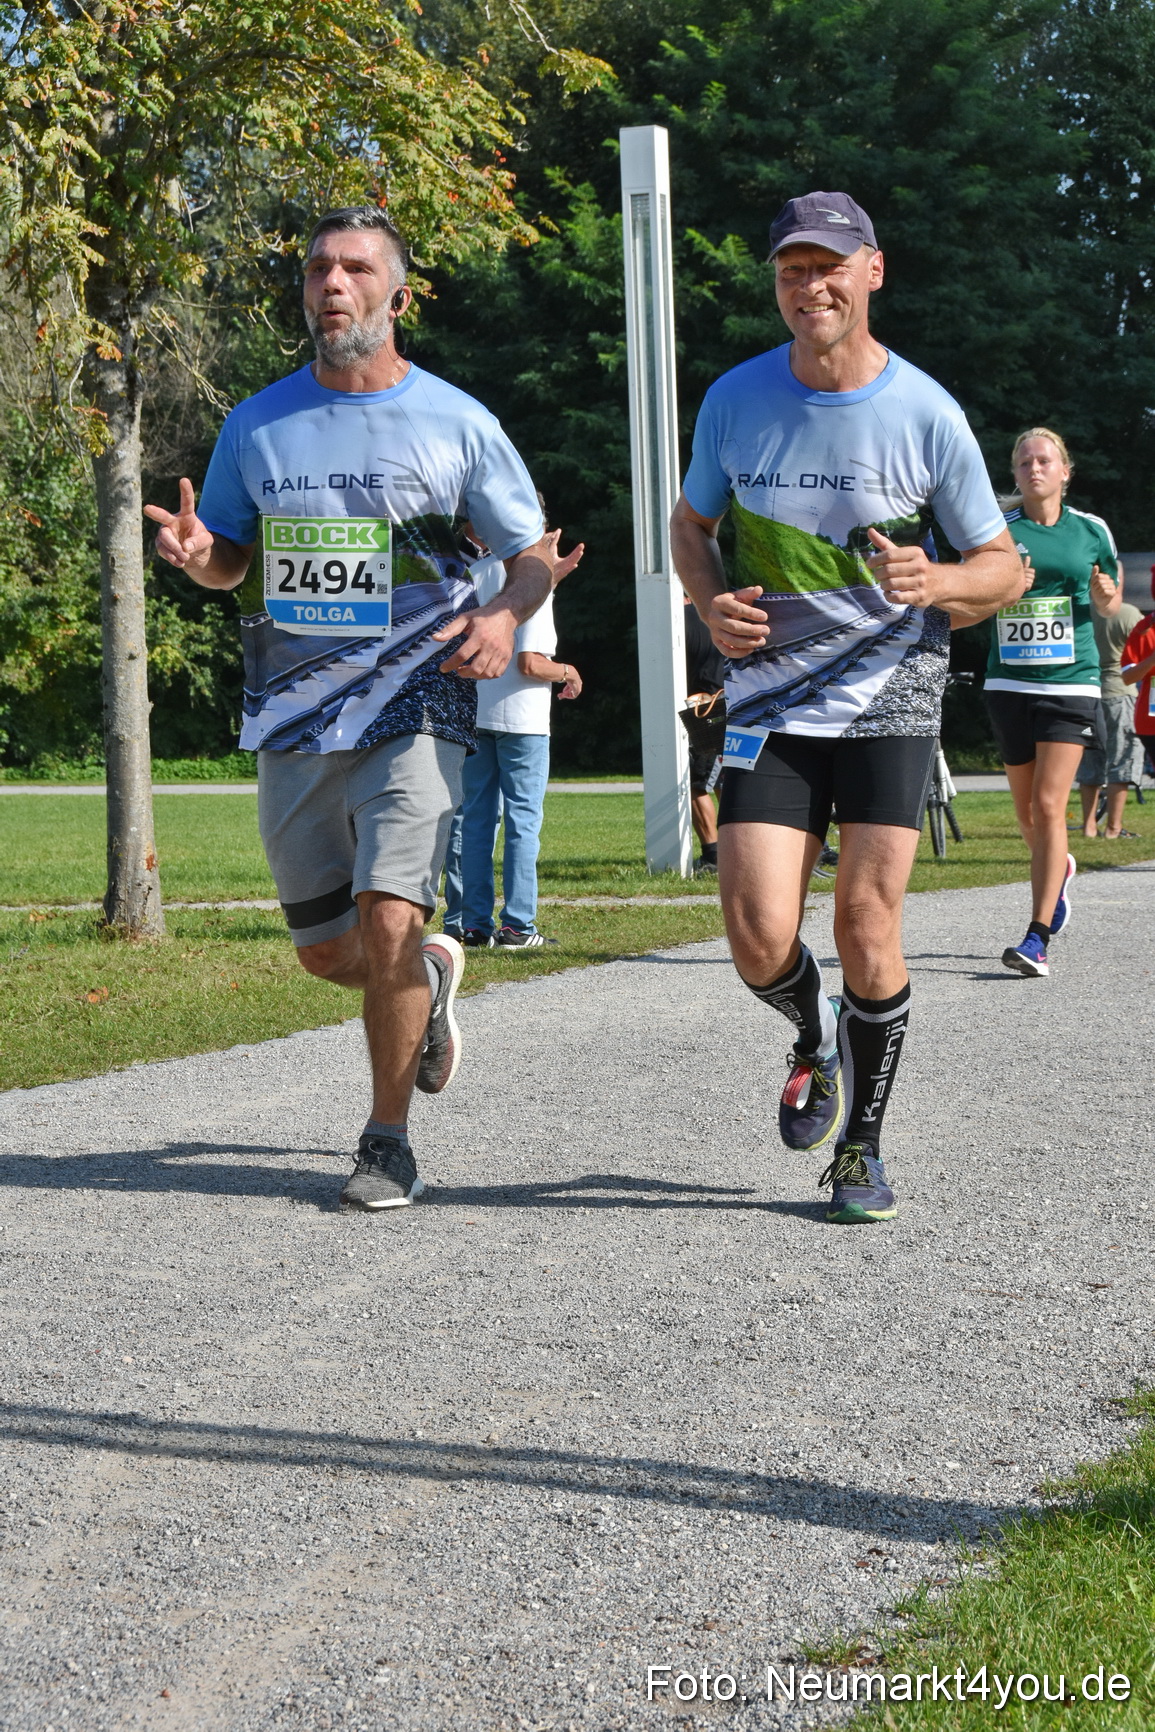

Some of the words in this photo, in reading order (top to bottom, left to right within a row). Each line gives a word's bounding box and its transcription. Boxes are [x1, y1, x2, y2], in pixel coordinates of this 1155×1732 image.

[271, 521, 380, 549] BOCK
[277, 558, 376, 595] 2494
[293, 605, 357, 622] TOLGA
[1003, 600, 1067, 617] BOCK
[1006, 620, 1065, 642] 2030
[1018, 647, 1053, 658] JULIA
